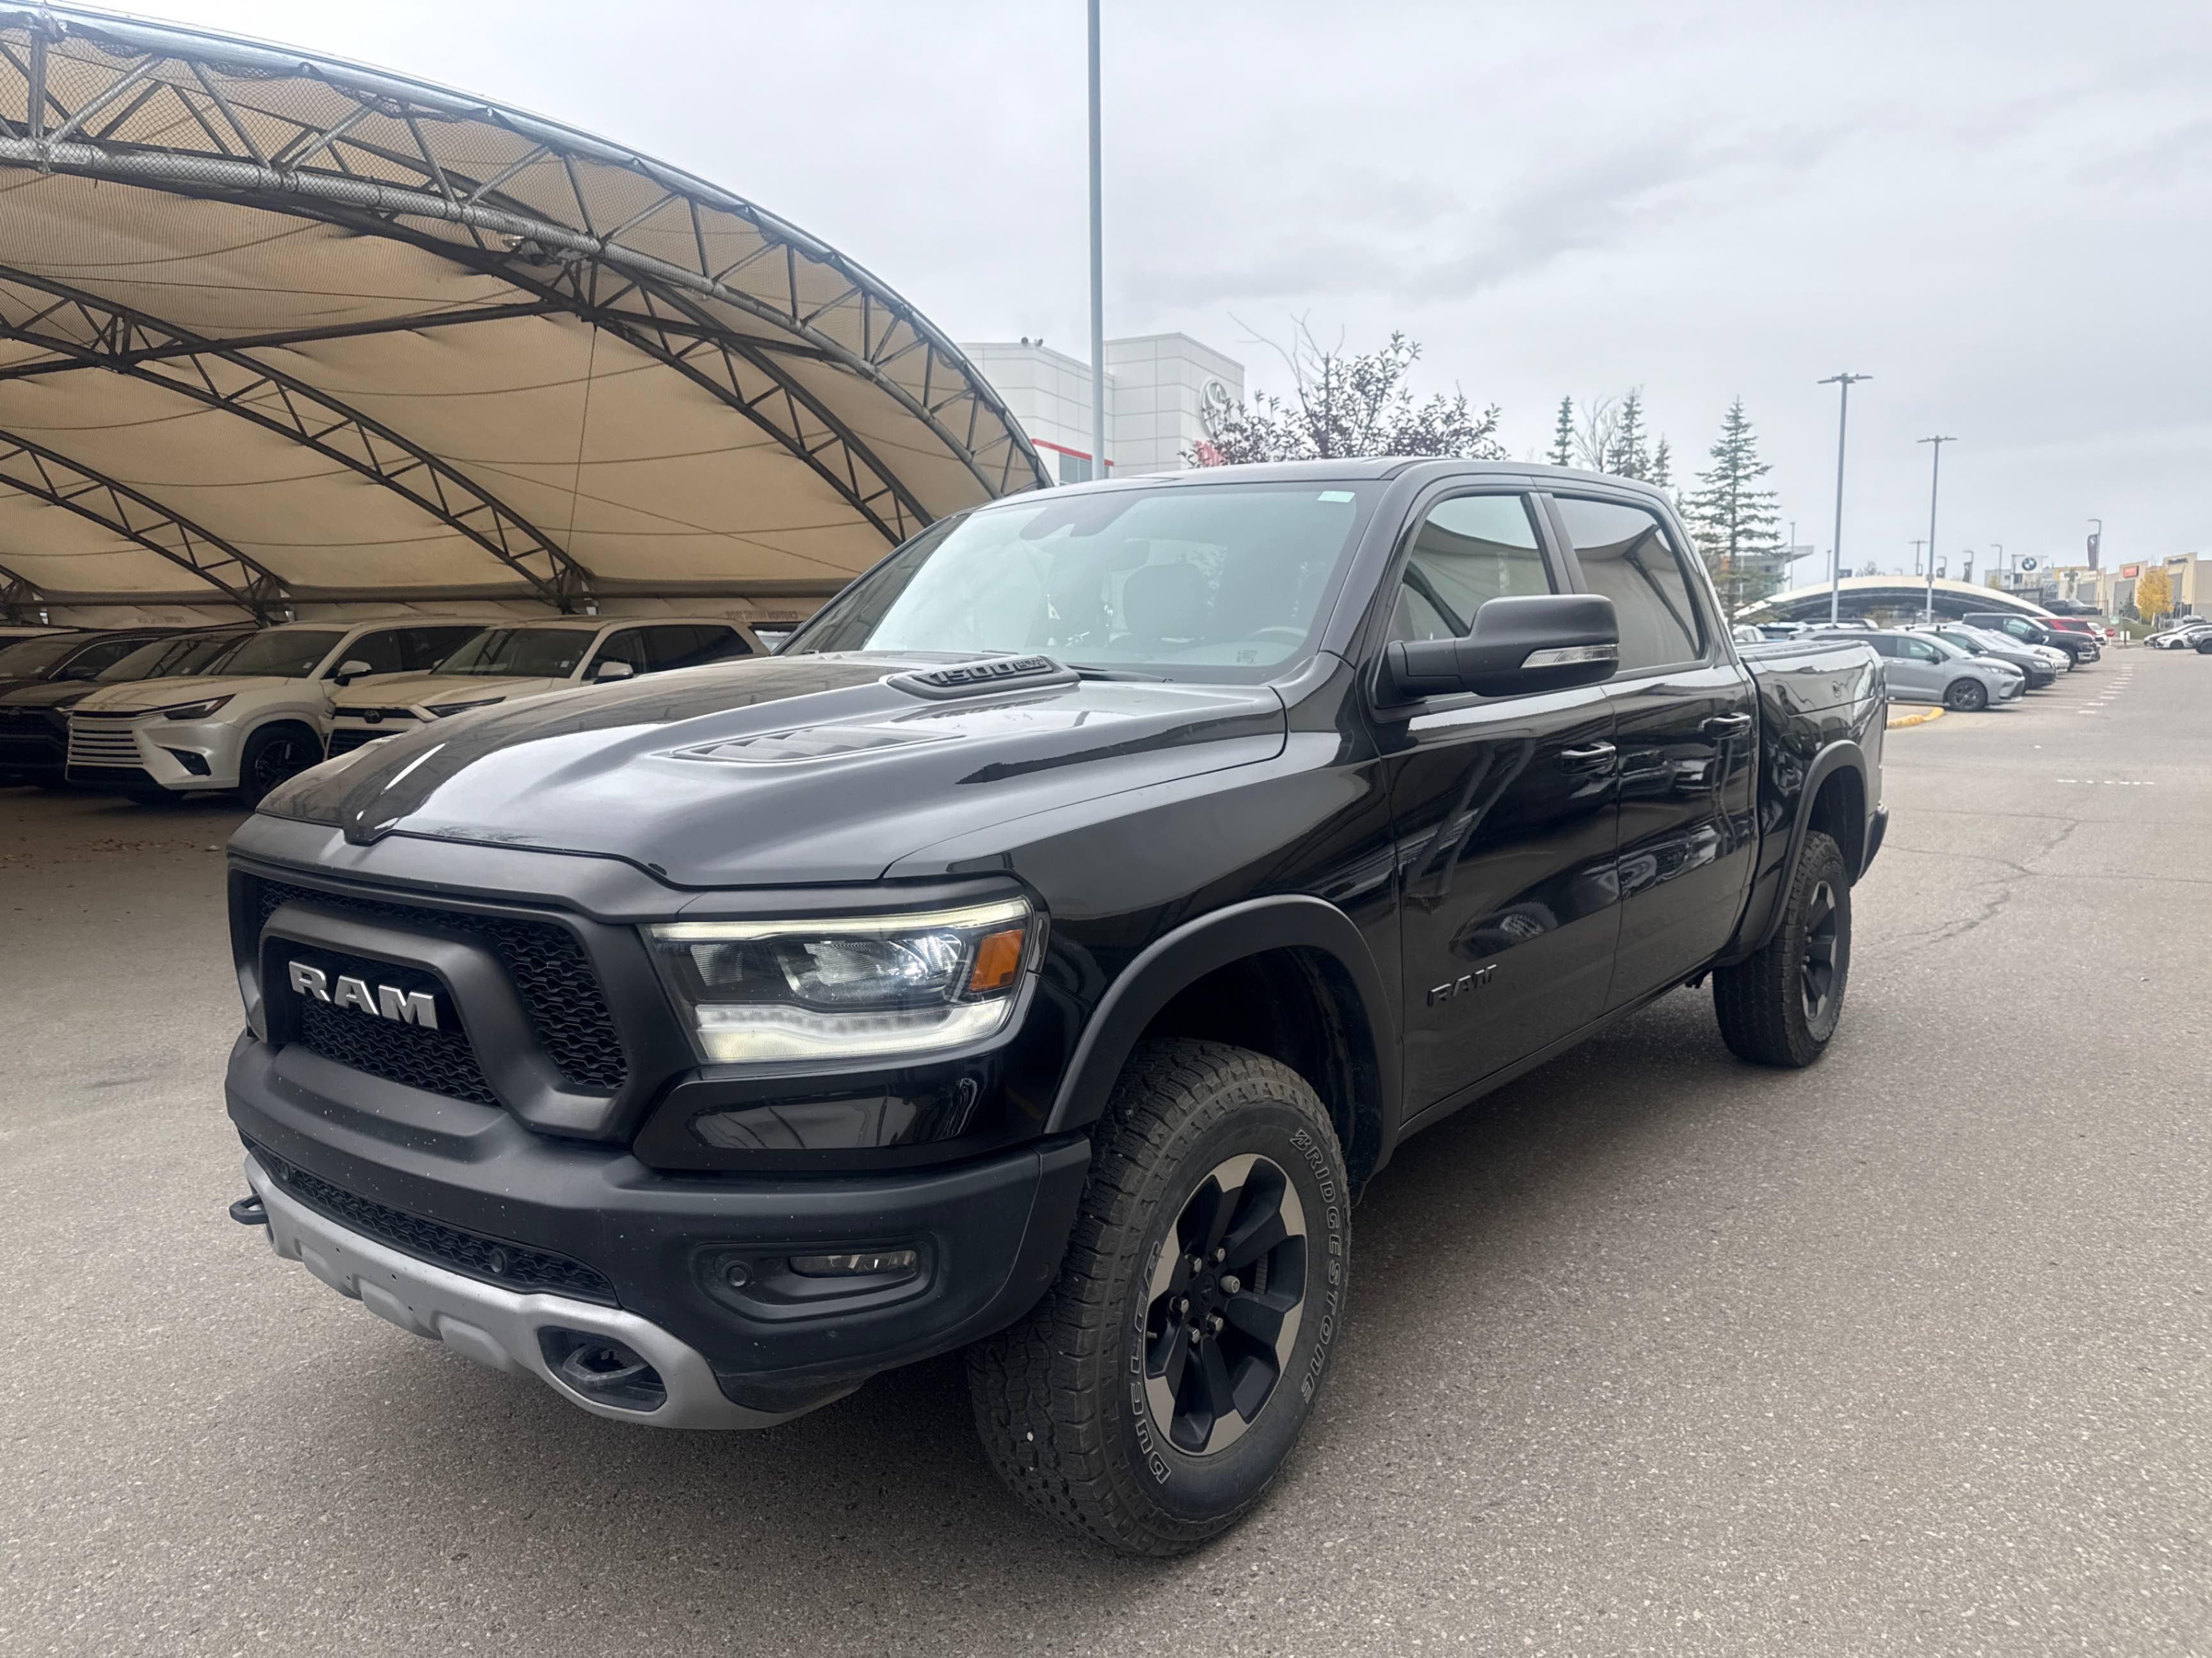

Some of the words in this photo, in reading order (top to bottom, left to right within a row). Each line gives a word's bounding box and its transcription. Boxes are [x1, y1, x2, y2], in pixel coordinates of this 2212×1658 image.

[930, 662, 1016, 683] 1500
[289, 961, 438, 1030] RAM
[1427, 964, 1498, 1008] RAM
[1289, 1129, 1342, 1405] BRIDGESTONE
